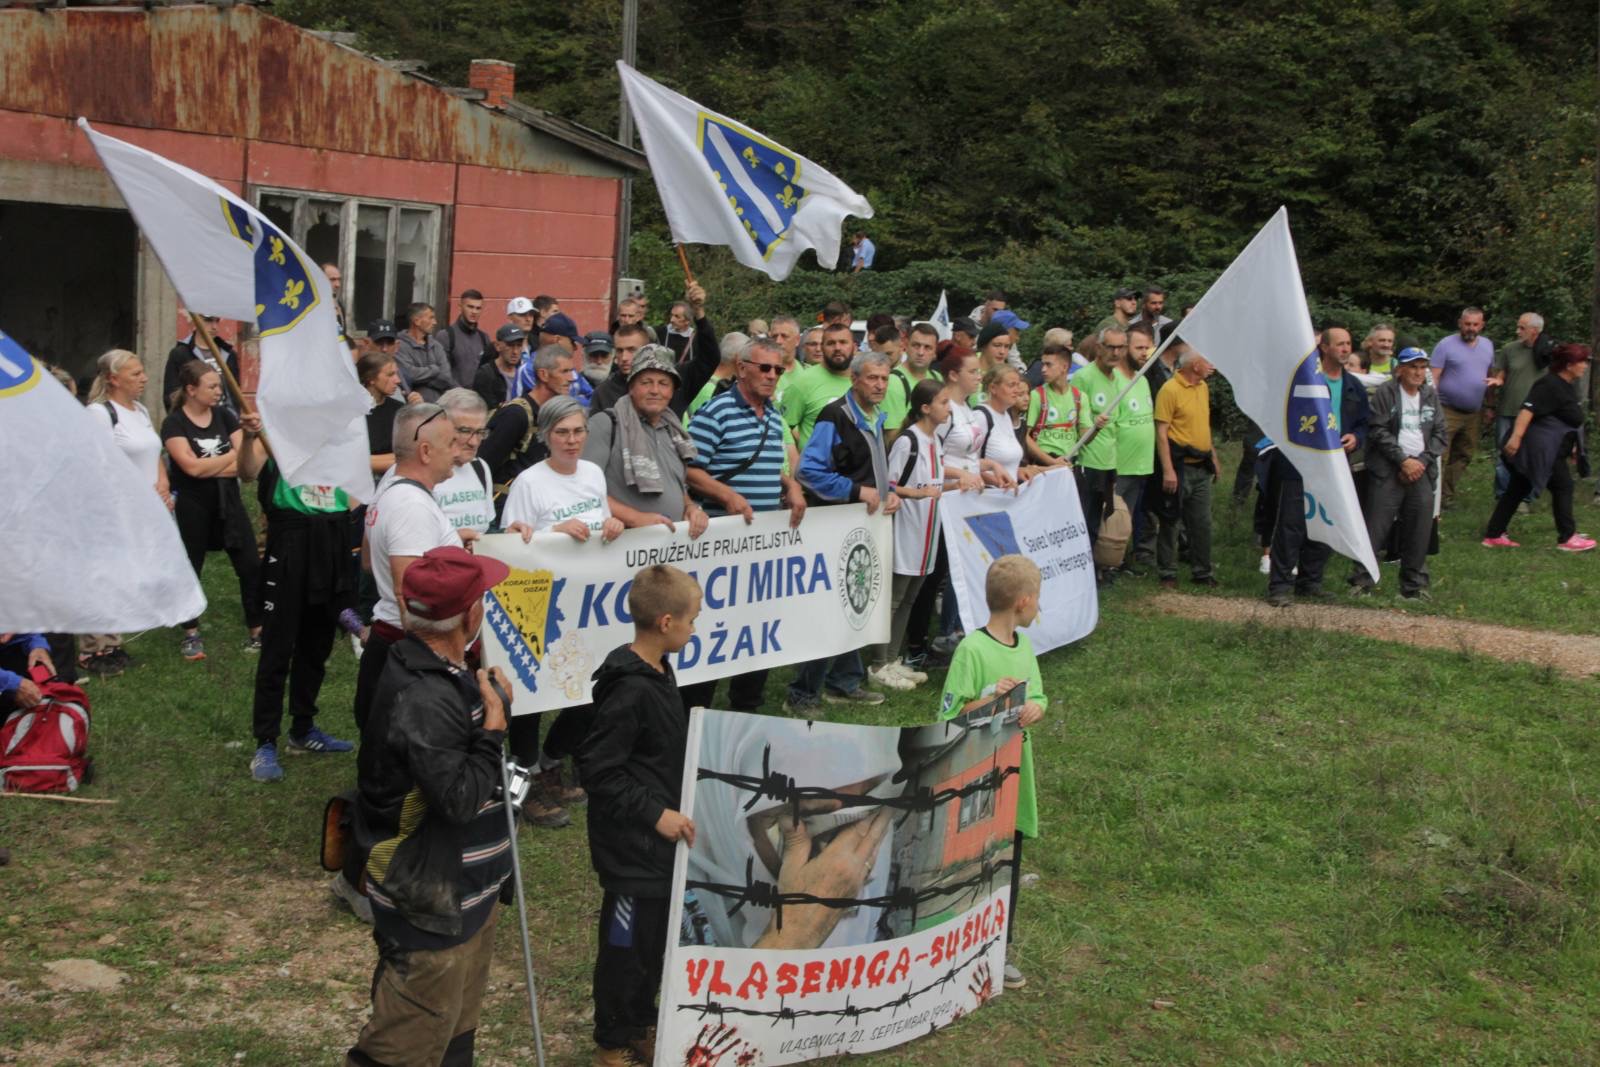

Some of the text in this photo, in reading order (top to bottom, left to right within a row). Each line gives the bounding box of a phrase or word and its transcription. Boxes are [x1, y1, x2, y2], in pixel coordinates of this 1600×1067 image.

[626, 528, 803, 567] UDRUŽENJE PRIJATELJSTVA
[1023, 536, 1048, 553] Savez
[578, 552, 832, 629] KOCI MIRA
[664, 619, 782, 671] DŽAK
[779, 1031, 846, 1054] VLASENICA
[848, 1029, 865, 1044] 21.
[870, 1013, 928, 1041] SEPTEMBAR
